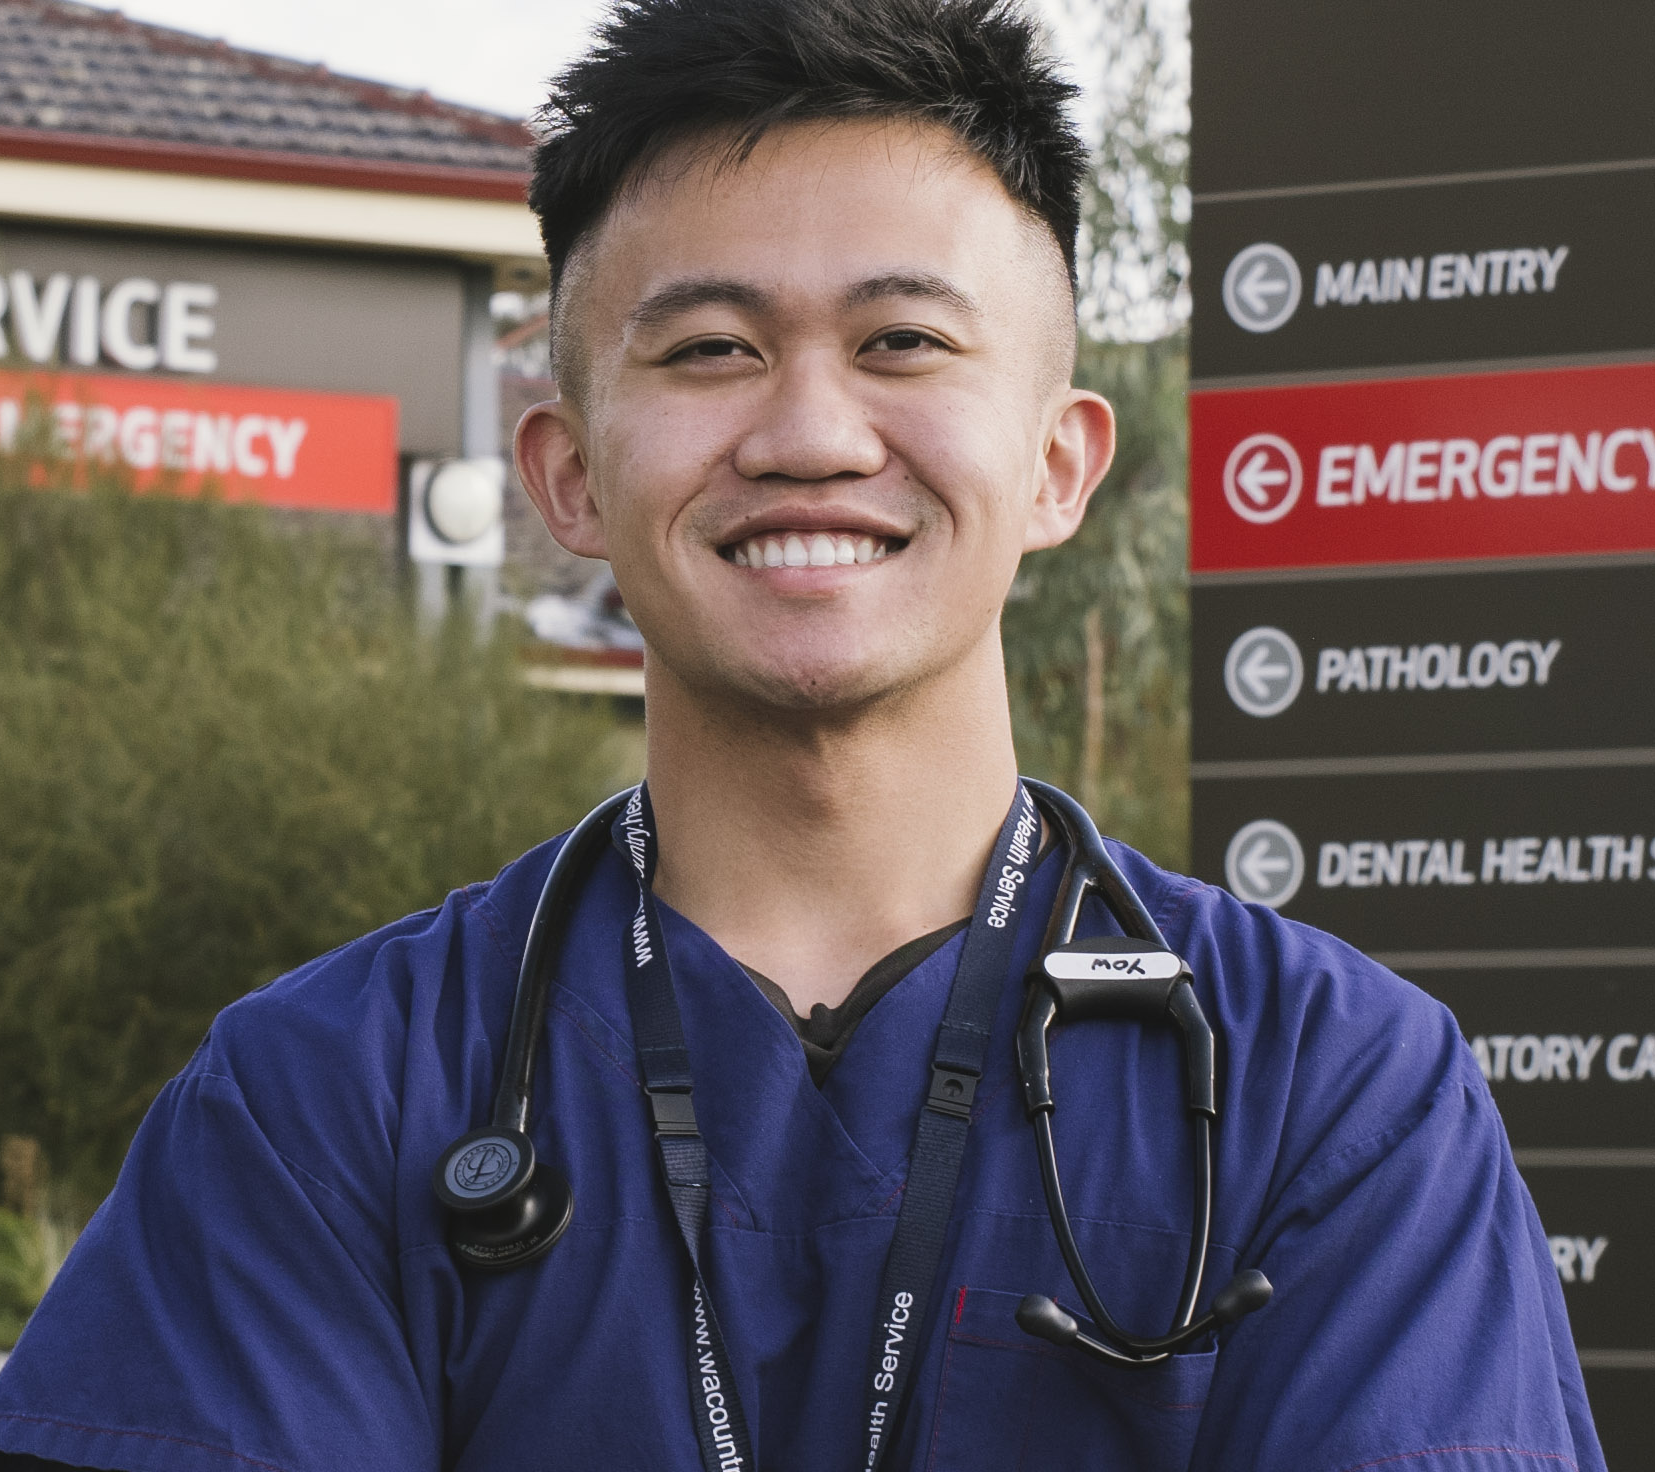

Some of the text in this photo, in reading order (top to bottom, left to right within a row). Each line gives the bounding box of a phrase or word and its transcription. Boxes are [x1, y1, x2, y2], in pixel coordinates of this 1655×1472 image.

[1314, 246, 1569, 307] MAIN ENTRY
[1316, 640, 1561, 694] PATHOLOGY
[1006, 807, 1038, 866] Health
[1317, 839, 1474, 887] DENTAL
[1482, 835, 1644, 885] HEALTH
[987, 865, 1025, 929] Service
[874, 1291, 914, 1392] Service
